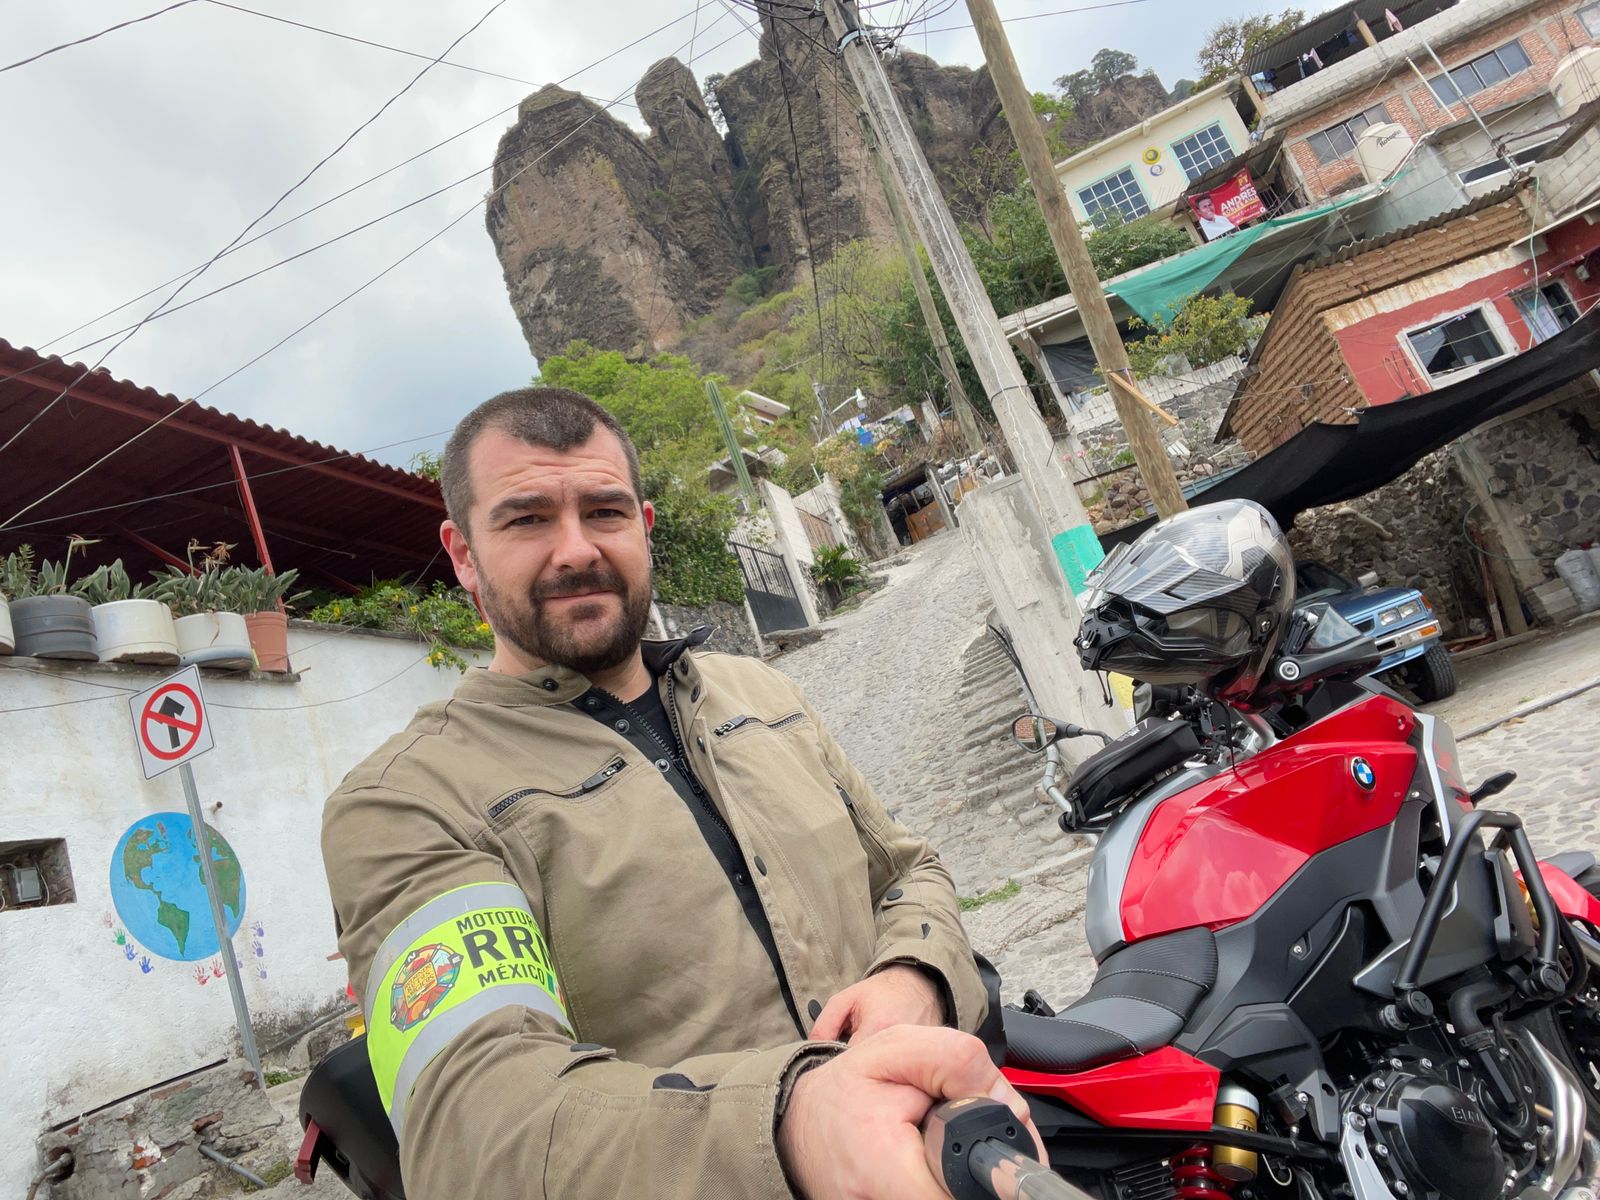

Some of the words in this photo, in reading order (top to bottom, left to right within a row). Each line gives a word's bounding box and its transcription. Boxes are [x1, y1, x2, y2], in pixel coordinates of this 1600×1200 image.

[1221, 187, 1257, 211] ANDRES
[456, 910, 538, 934] MOTOTUR
[478, 963, 545, 987] MÉXICO
